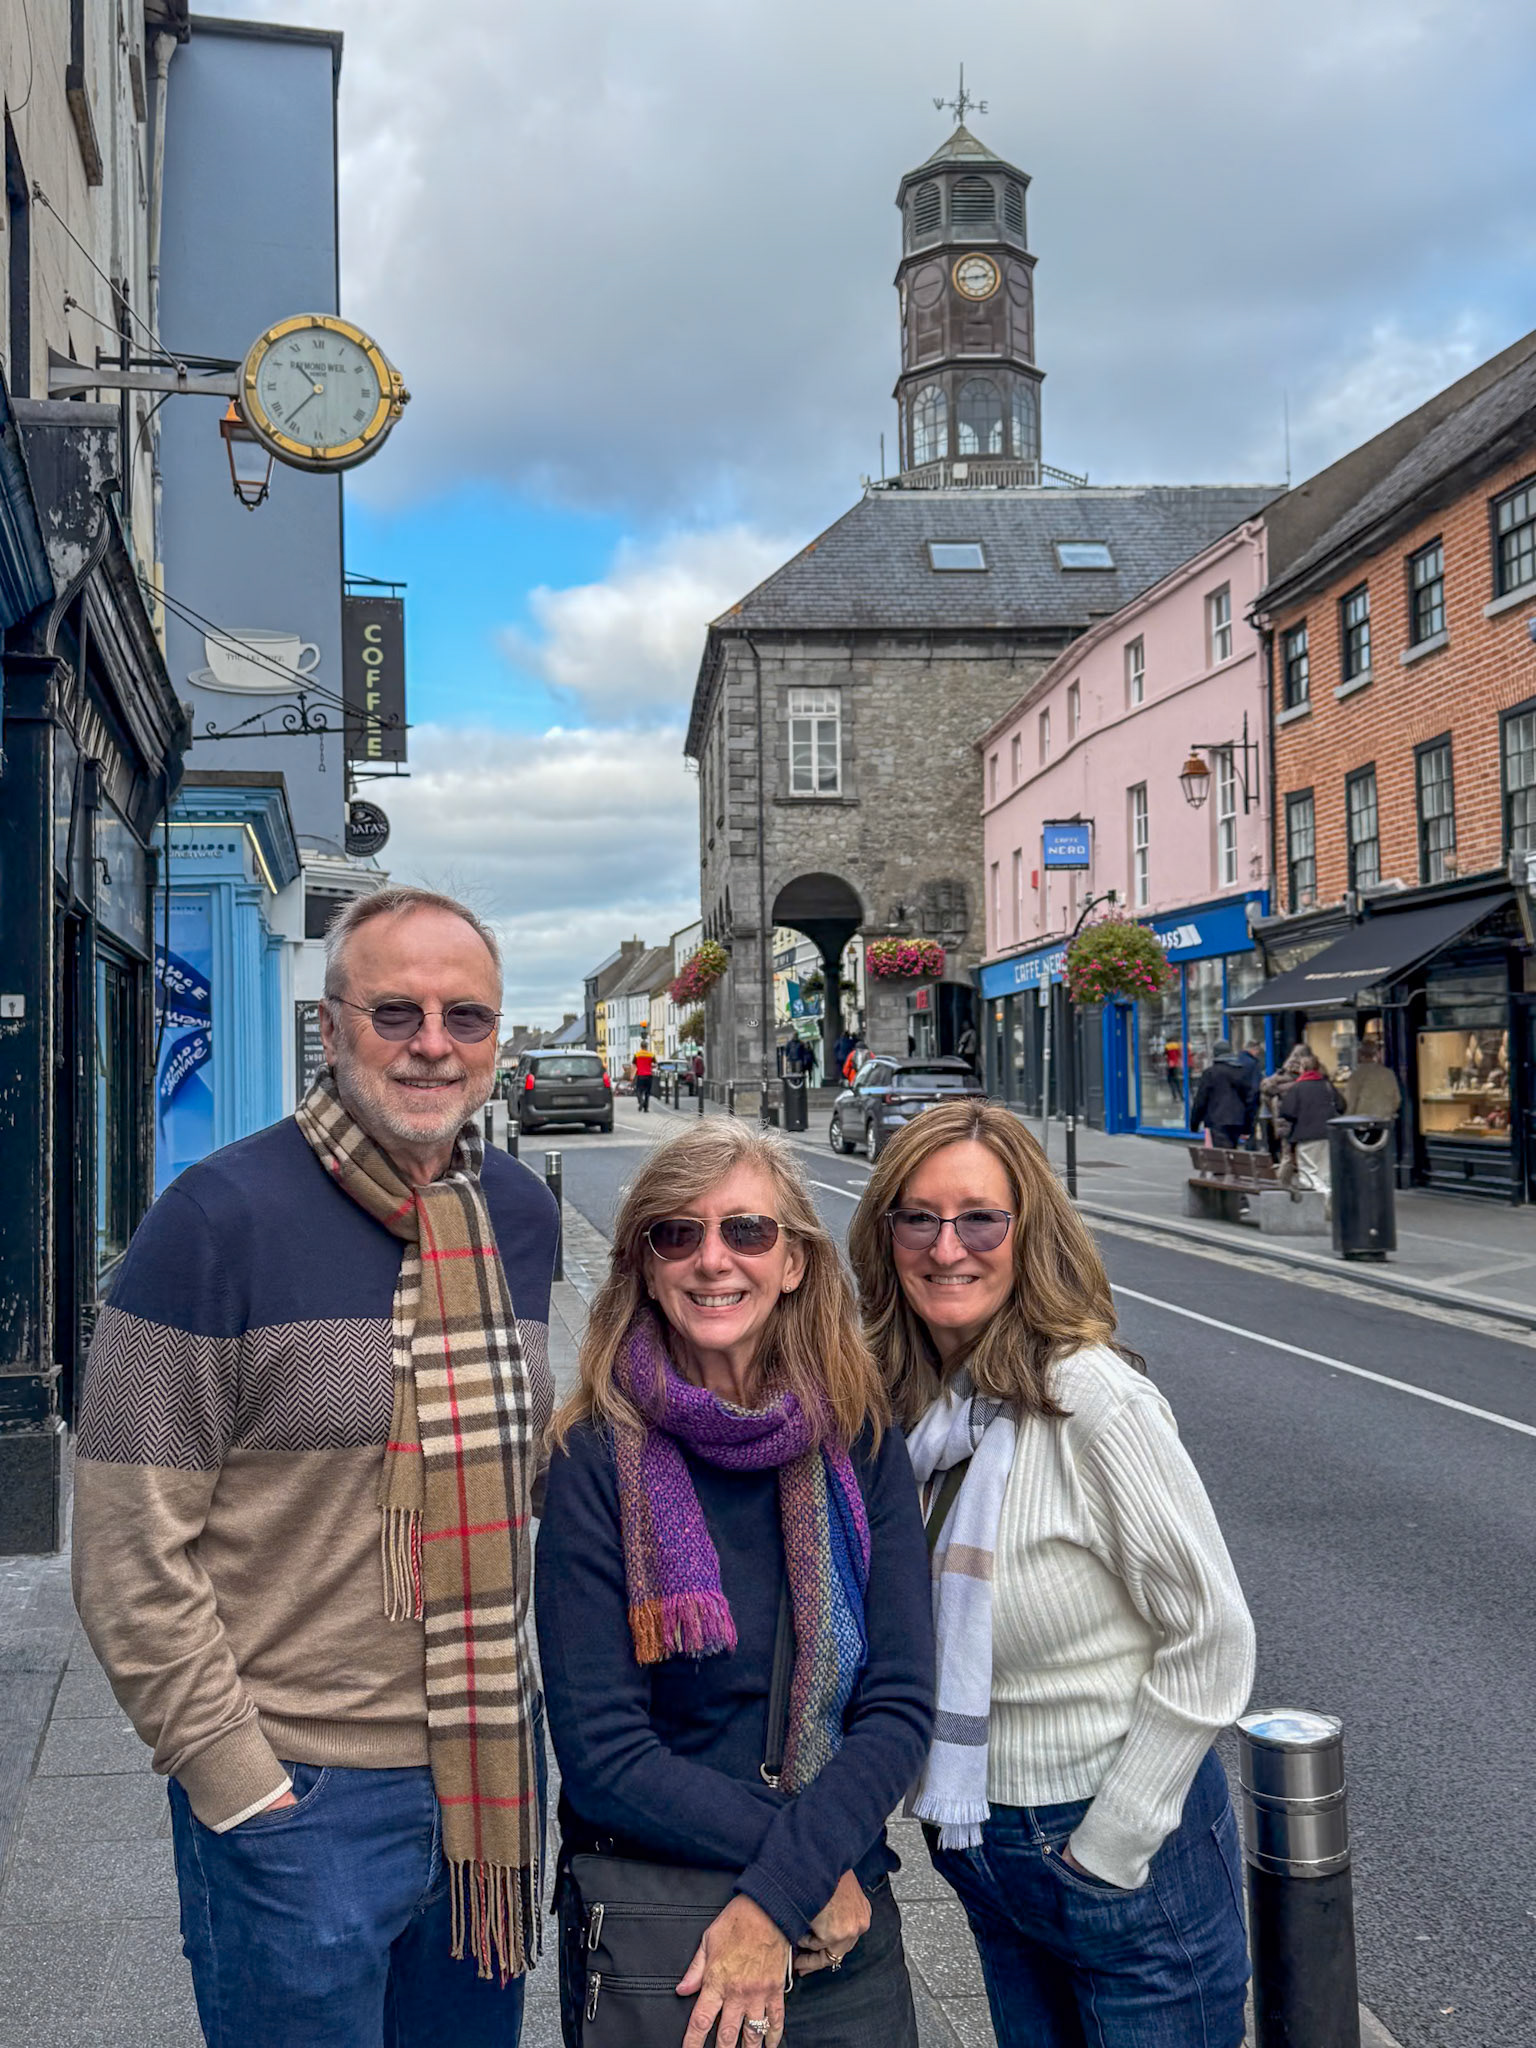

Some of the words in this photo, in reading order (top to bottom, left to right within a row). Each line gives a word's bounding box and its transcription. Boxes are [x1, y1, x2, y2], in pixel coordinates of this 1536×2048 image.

[290, 361, 327, 371] RAYMOND
[328, 363, 346, 373] WEIL
[361, 624, 384, 757] COFFEE
[1048, 845, 1085, 854] NERO
